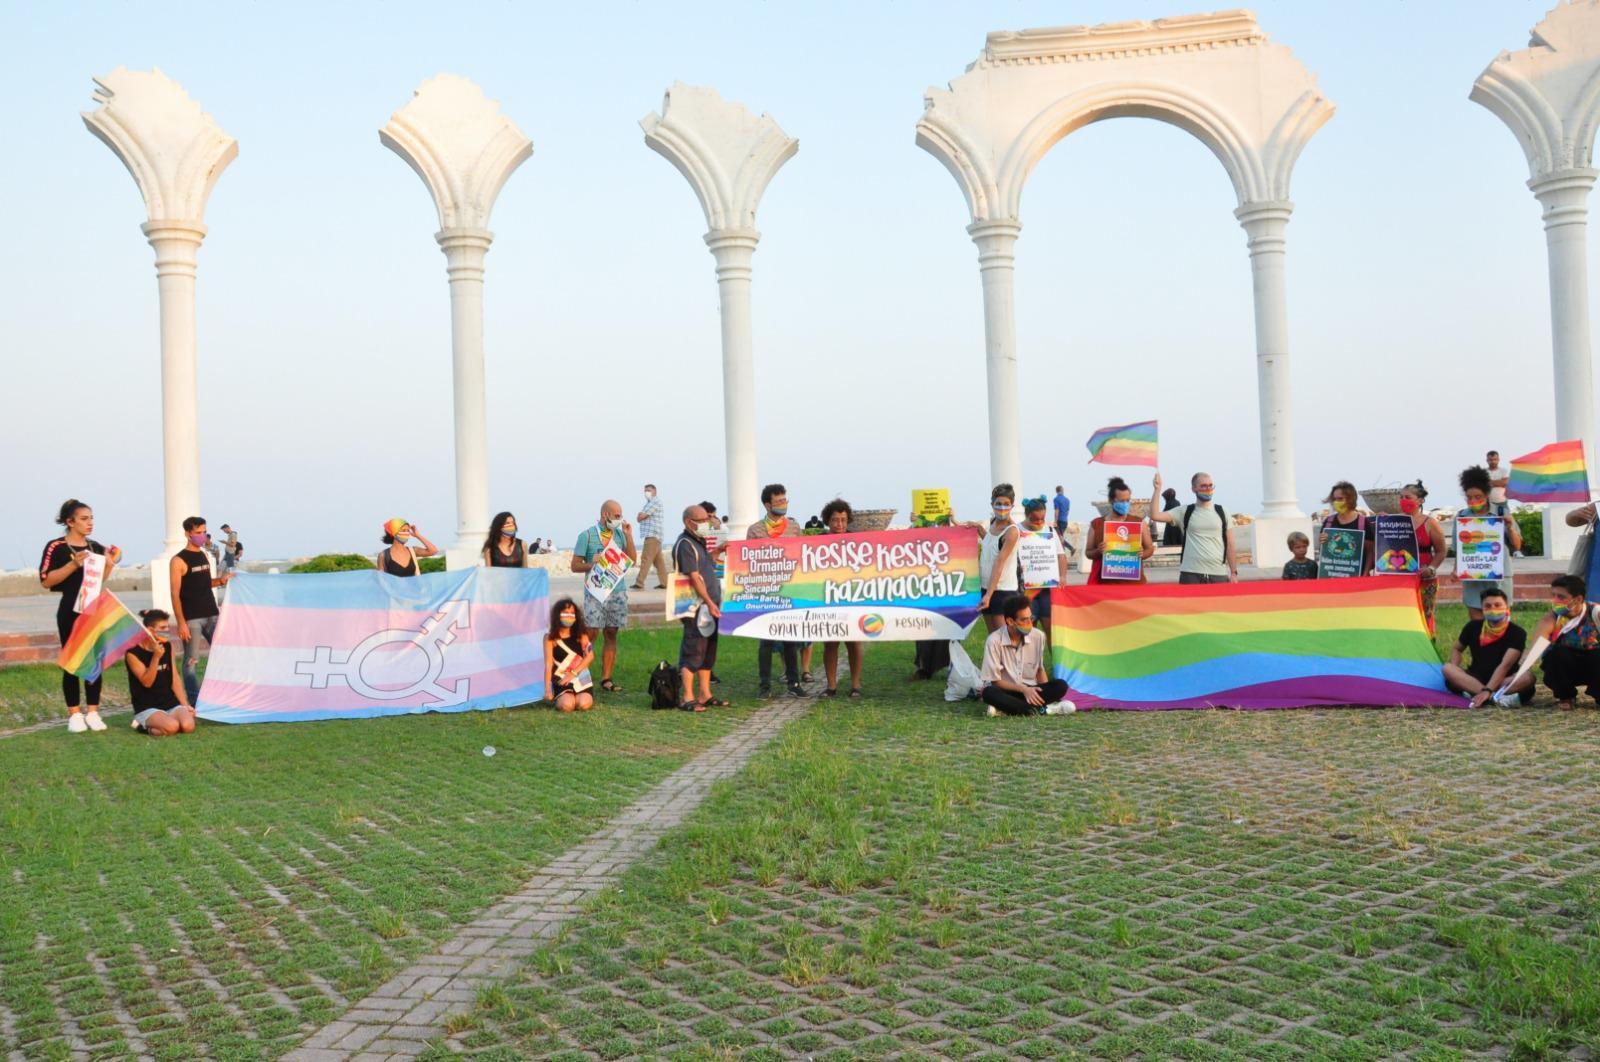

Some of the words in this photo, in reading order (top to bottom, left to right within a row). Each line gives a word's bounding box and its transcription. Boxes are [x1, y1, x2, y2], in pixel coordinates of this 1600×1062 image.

[741, 545, 784, 561] Denizler
[749, 559, 798, 573] Ormanlar
[734, 572, 793, 586] Kaplumbağalar
[744, 584, 782, 595] Sincaplar
